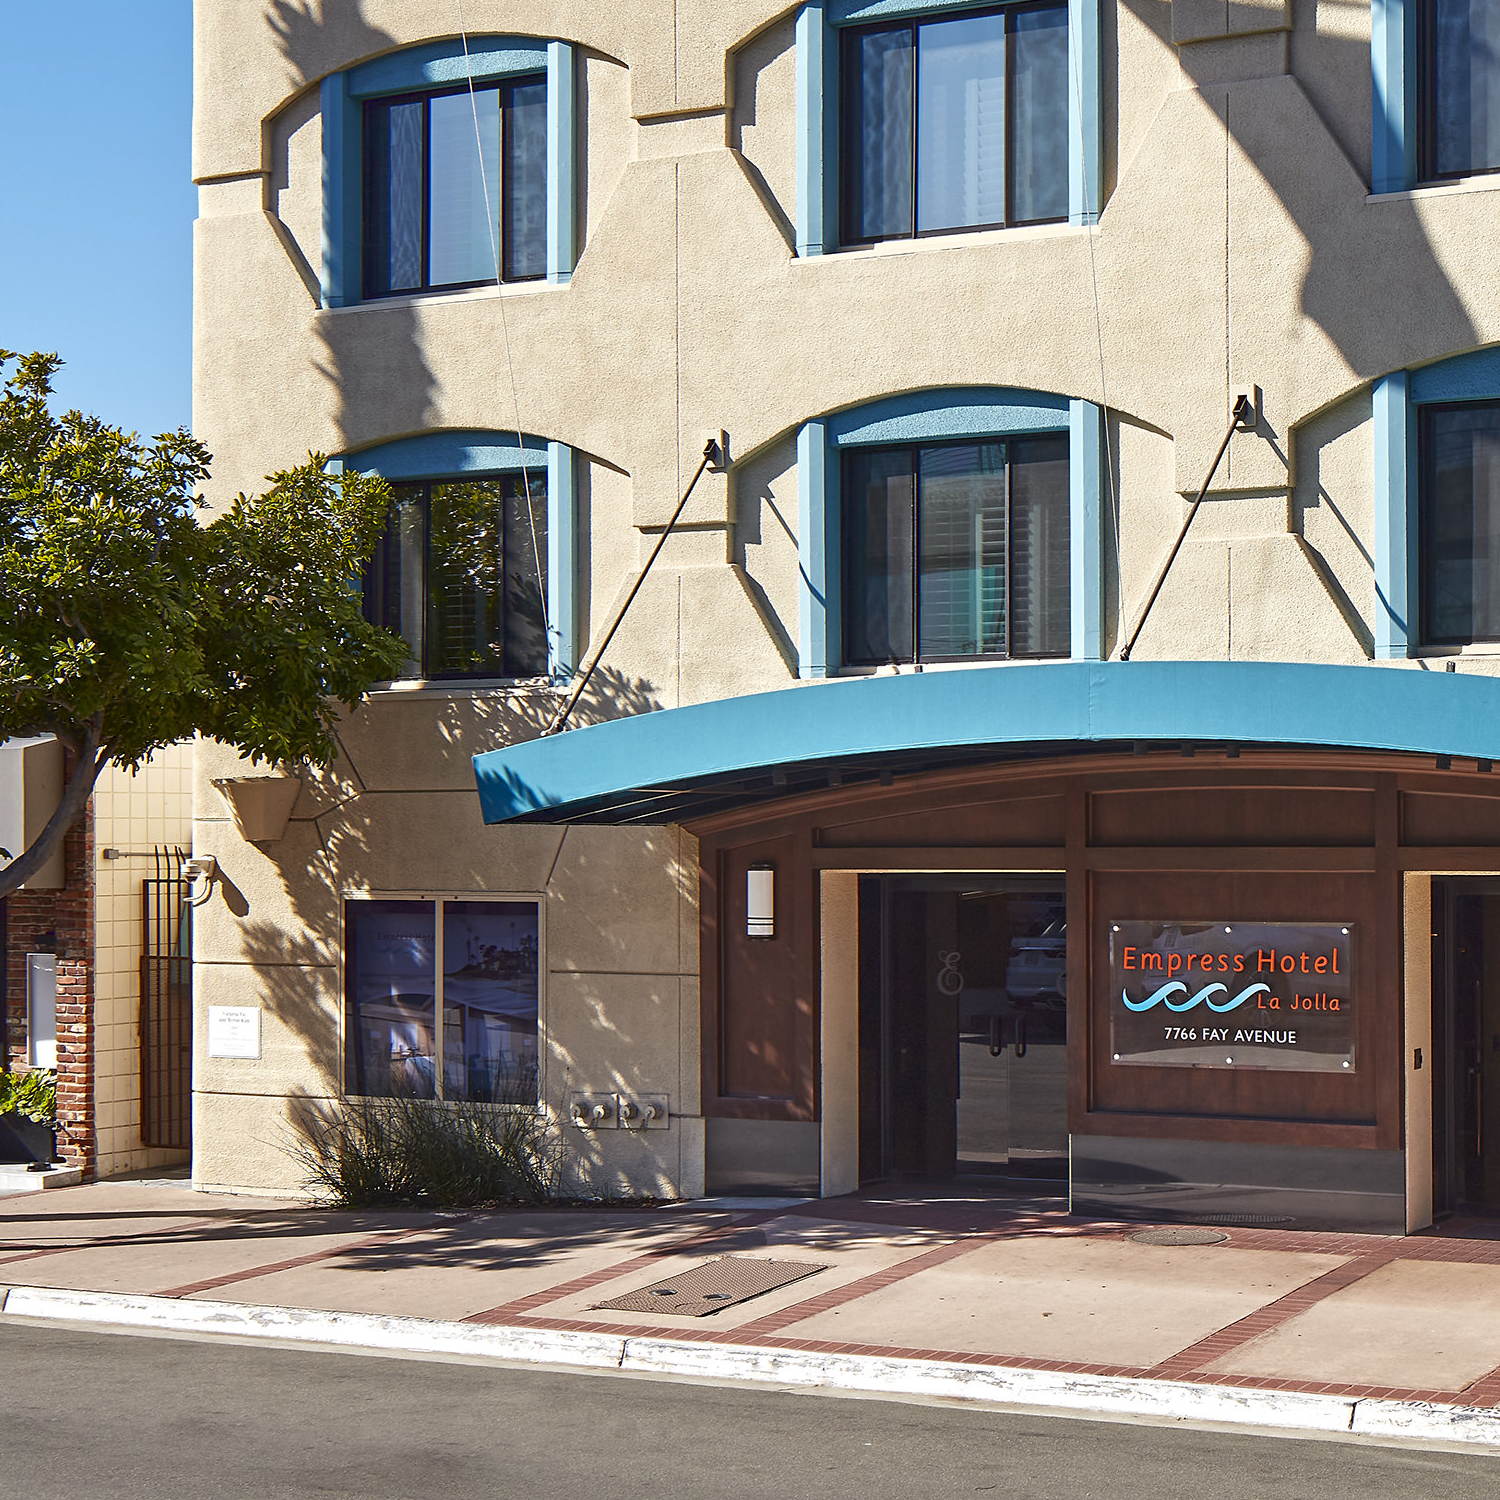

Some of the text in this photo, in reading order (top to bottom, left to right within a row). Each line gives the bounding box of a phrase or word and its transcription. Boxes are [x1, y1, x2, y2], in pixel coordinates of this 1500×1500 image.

[1122, 946, 1340, 978] Empress Hotel
[1257, 993, 1341, 1011] La Jolla
[1164, 1027, 1297, 1044] 7766 FAY AVENUE
